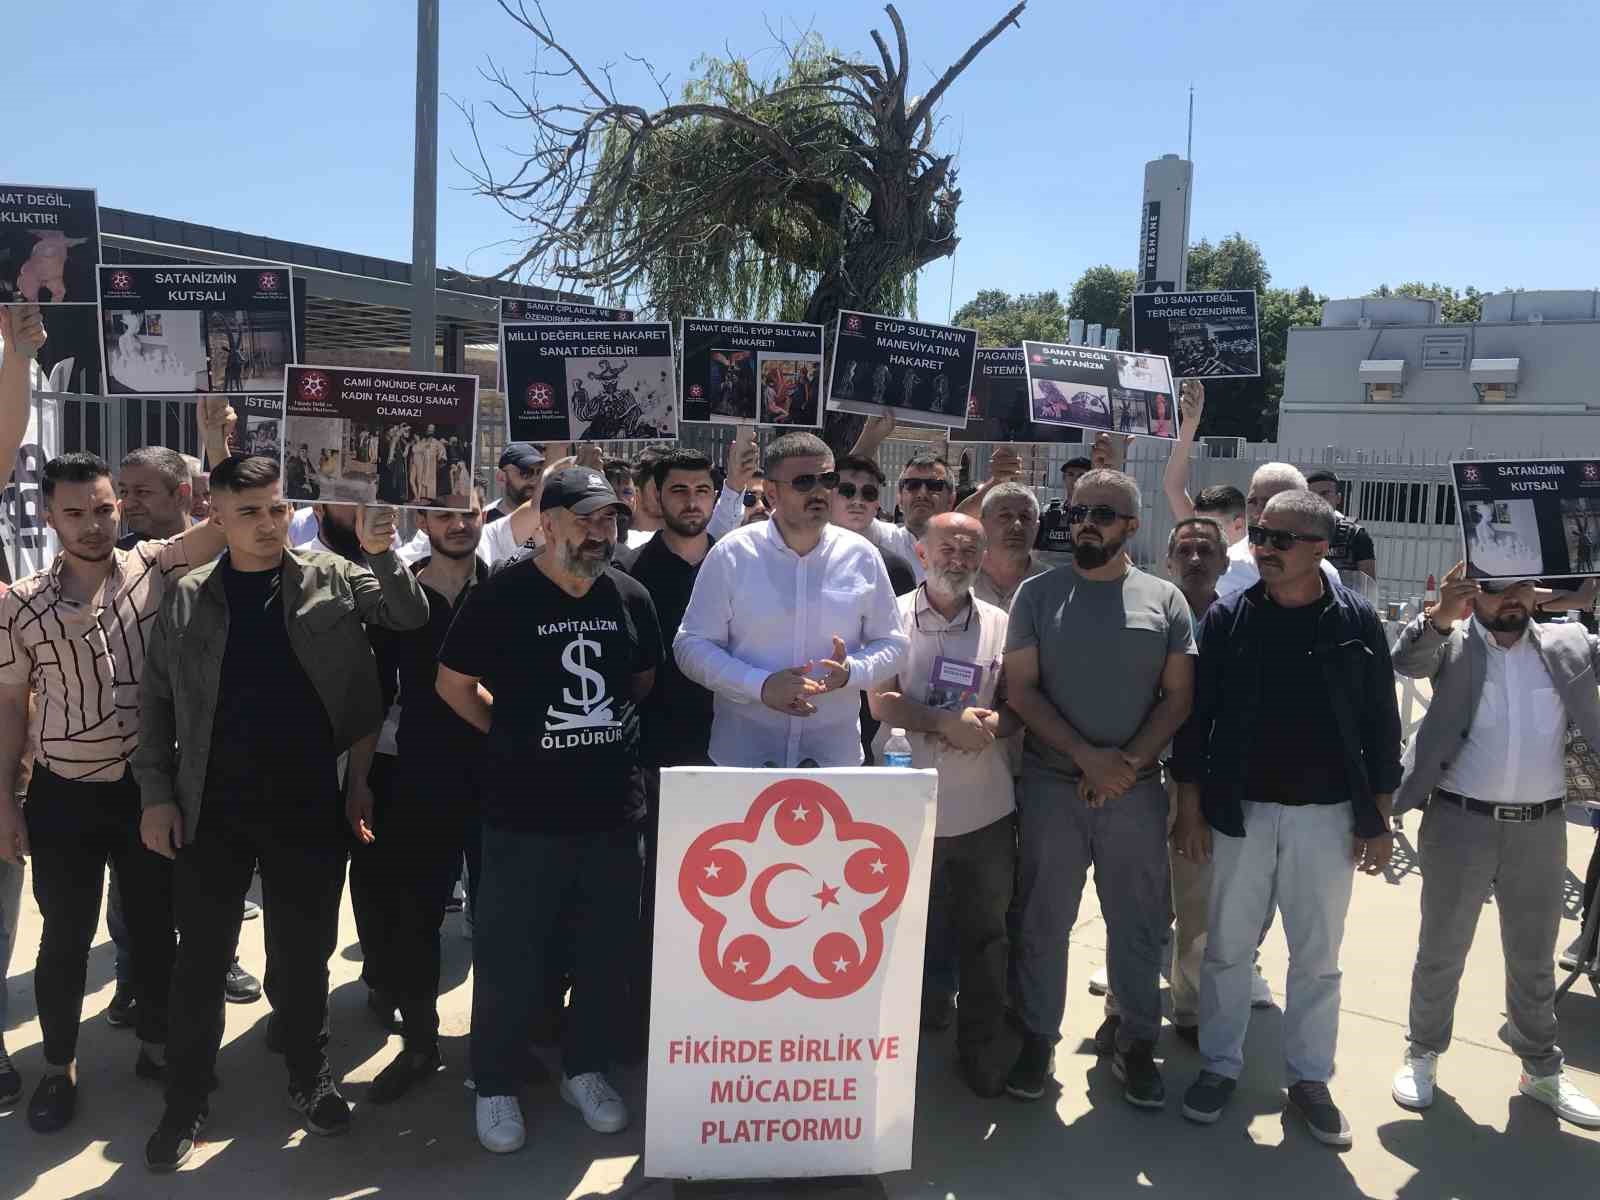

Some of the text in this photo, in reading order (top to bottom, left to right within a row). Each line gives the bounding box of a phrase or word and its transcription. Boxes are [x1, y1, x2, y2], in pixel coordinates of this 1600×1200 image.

[155, 271, 237, 284] SATANİZMİN
[168, 291, 226, 301] KUTSALI
[1154, 297, 1168, 305] BU
[1170, 295, 1204, 304] SANAT
[508, 330, 667, 341] MİLLİ DEĞERLERE HAKARET
[689, 324, 719, 332] SANAT
[751, 326, 773, 335] EYÜP
[874, 321, 906, 334] EYÜP
[907, 327, 966, 343] SULTAN'IN
[539, 346, 578, 356] SANAT
[876, 337, 960, 357] MANEVİYATINA
[1042, 347, 1077, 357] SANAT
[889, 354, 944, 370] HAKARET
[983, 364, 1026, 375] İSTEMİY
[419, 382, 456, 393] ÇIPLAK
[244, 395, 283, 410] İSTEM
[341, 391, 460, 407] KADIN TABLOSU SANAT
[1497, 464, 1565, 476] SATANİZMİN
[1511, 480, 1559, 492] KUTSALI
[537, 618, 618, 636] KAPİTALİZM
[541, 727, 623, 749] ÖLDÜRÜR
[669, 1033, 899, 1064] FİKİRDE BİRLİK VE
[710, 1075, 857, 1104] MÜCADELE
[701, 1117, 862, 1144] PLATFORMU
